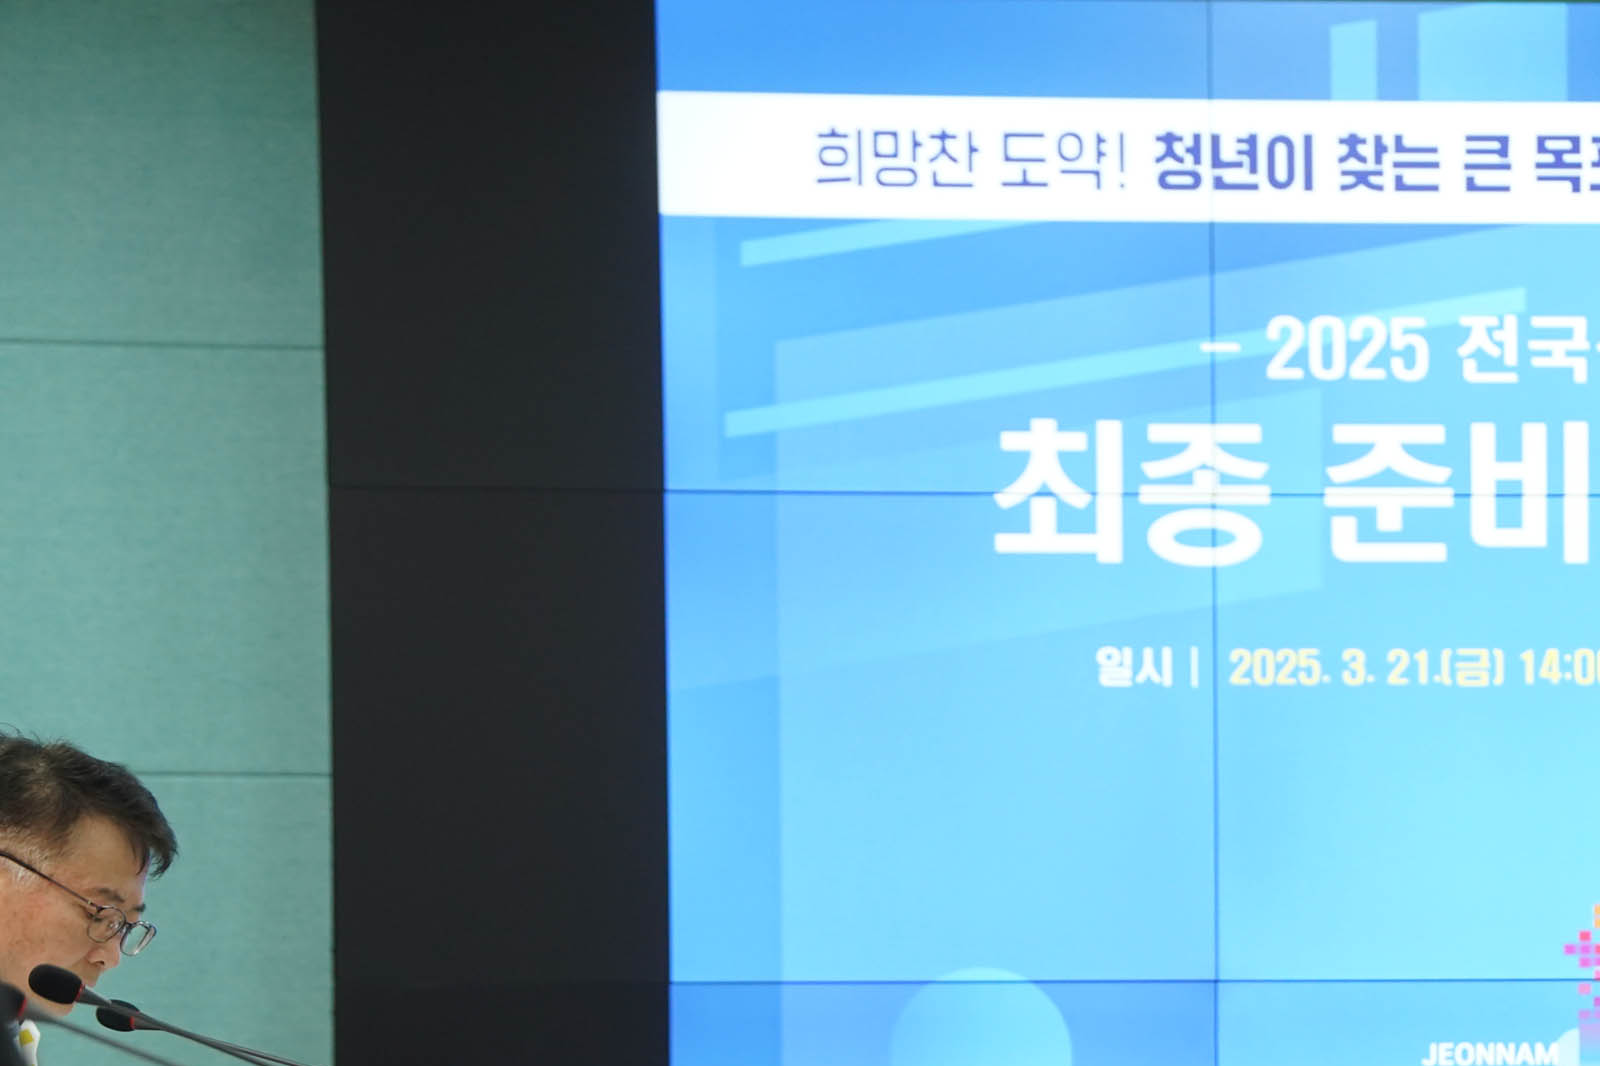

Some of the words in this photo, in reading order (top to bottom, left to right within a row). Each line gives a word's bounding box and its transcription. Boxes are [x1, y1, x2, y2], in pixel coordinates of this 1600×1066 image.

[817, 128, 979, 188] 희망찬
[1002, 132, 1125, 189] 도약!
[1155, 132, 1314, 191] 청년이
[1338, 133, 1441, 191] 찾는
[1464, 135, 1512, 192] 큰
[1266, 315, 1430, 382] 2025
[994, 418, 1272, 568] 최종
[1096, 646, 1173, 688] 일시
[1230, 647, 1331, 687] 2025.
[1342, 647, 1375, 687] 3.
